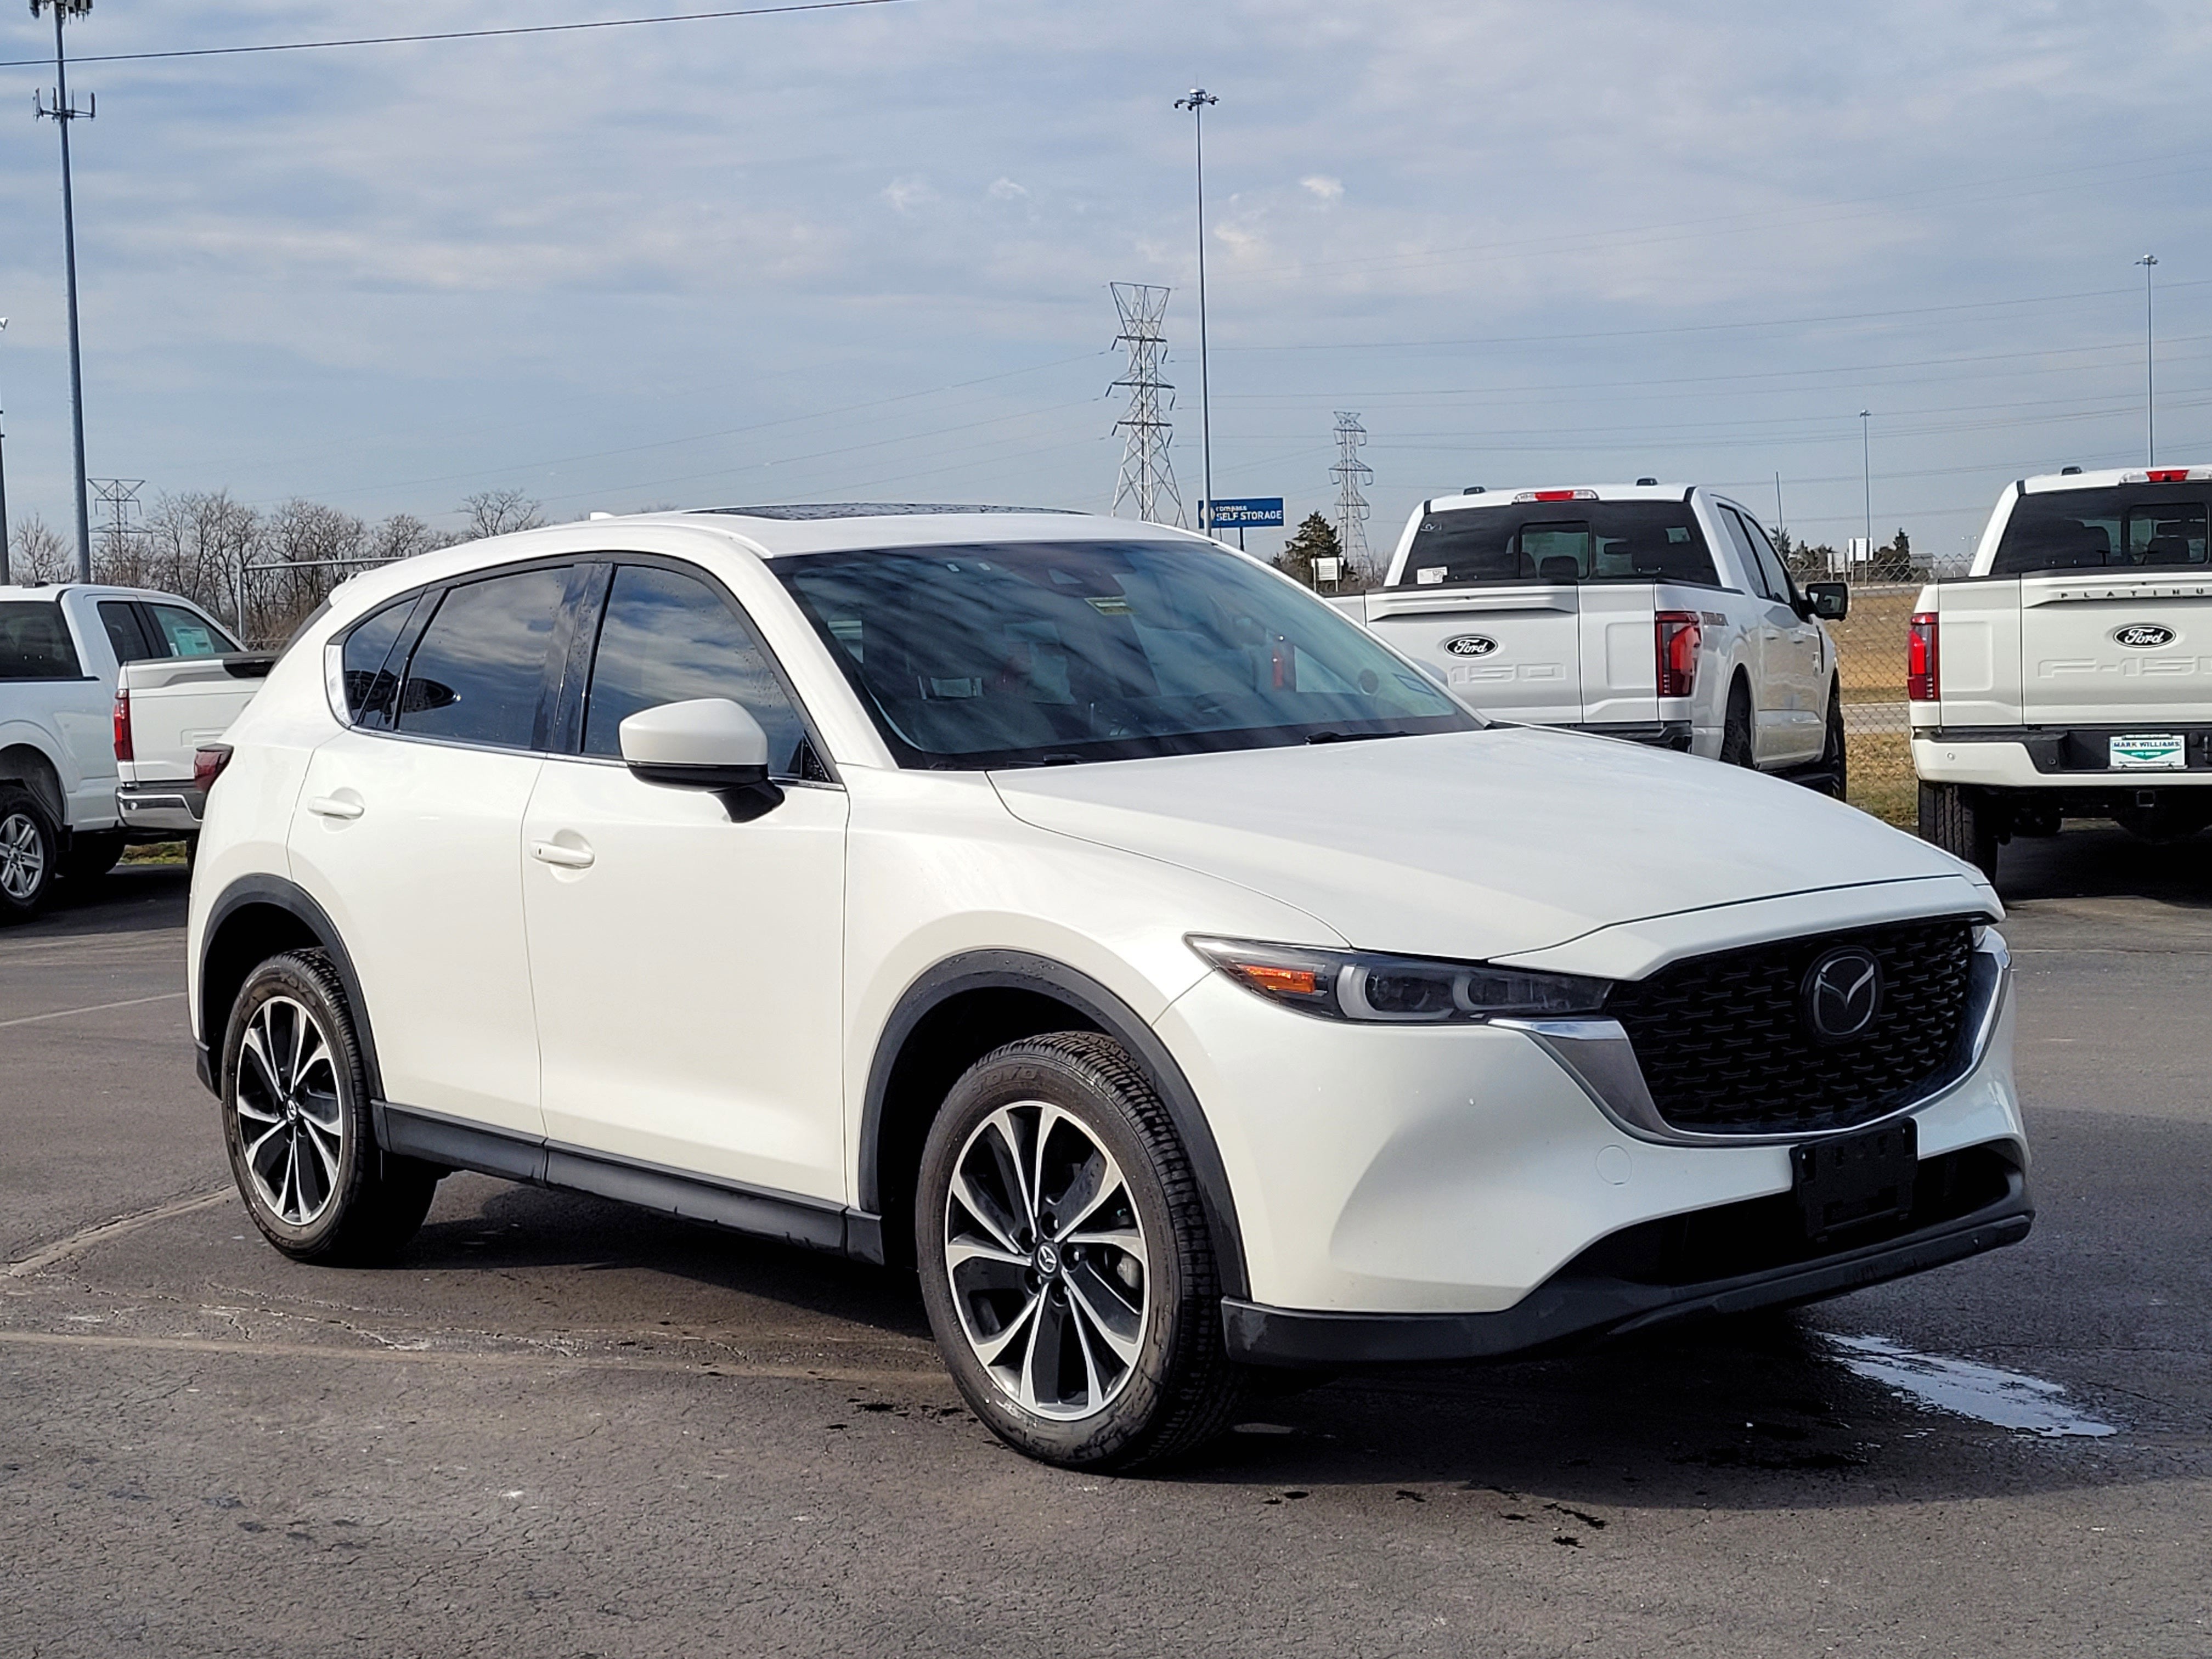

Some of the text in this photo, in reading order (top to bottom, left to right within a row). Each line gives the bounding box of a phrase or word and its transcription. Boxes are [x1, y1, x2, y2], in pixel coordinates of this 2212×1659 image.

[1216, 510, 1282, 521] SELF STORAGE
[2124, 628, 2164, 644] Ford
[1454, 639, 1489, 653] Ford
